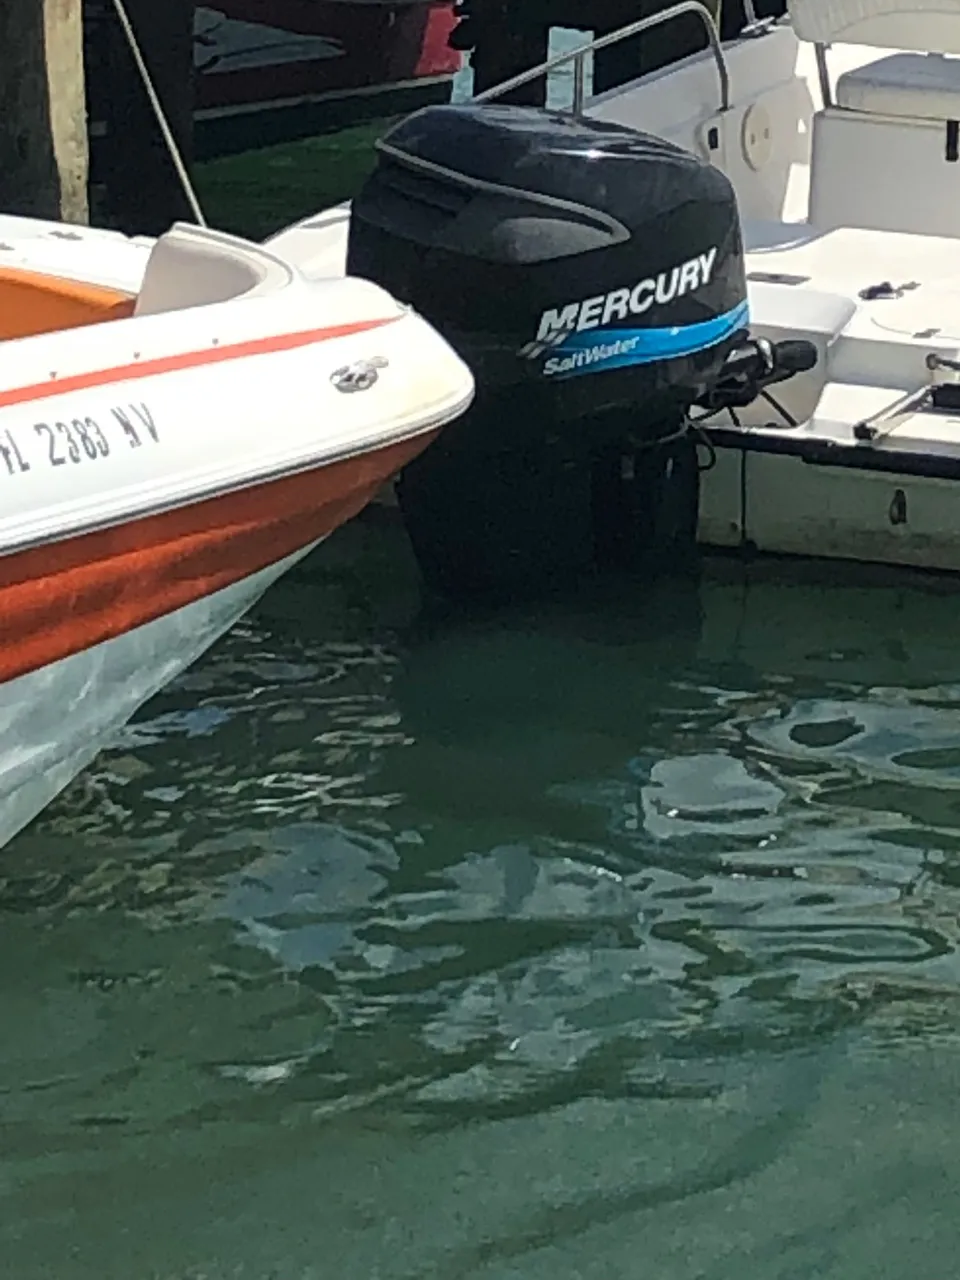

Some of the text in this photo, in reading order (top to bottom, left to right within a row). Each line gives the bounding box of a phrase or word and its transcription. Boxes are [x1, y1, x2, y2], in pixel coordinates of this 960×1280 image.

[533, 246, 718, 344] MERCURY
[542, 335, 640, 376] SaltWater
[33, 417, 111, 467] 2383
